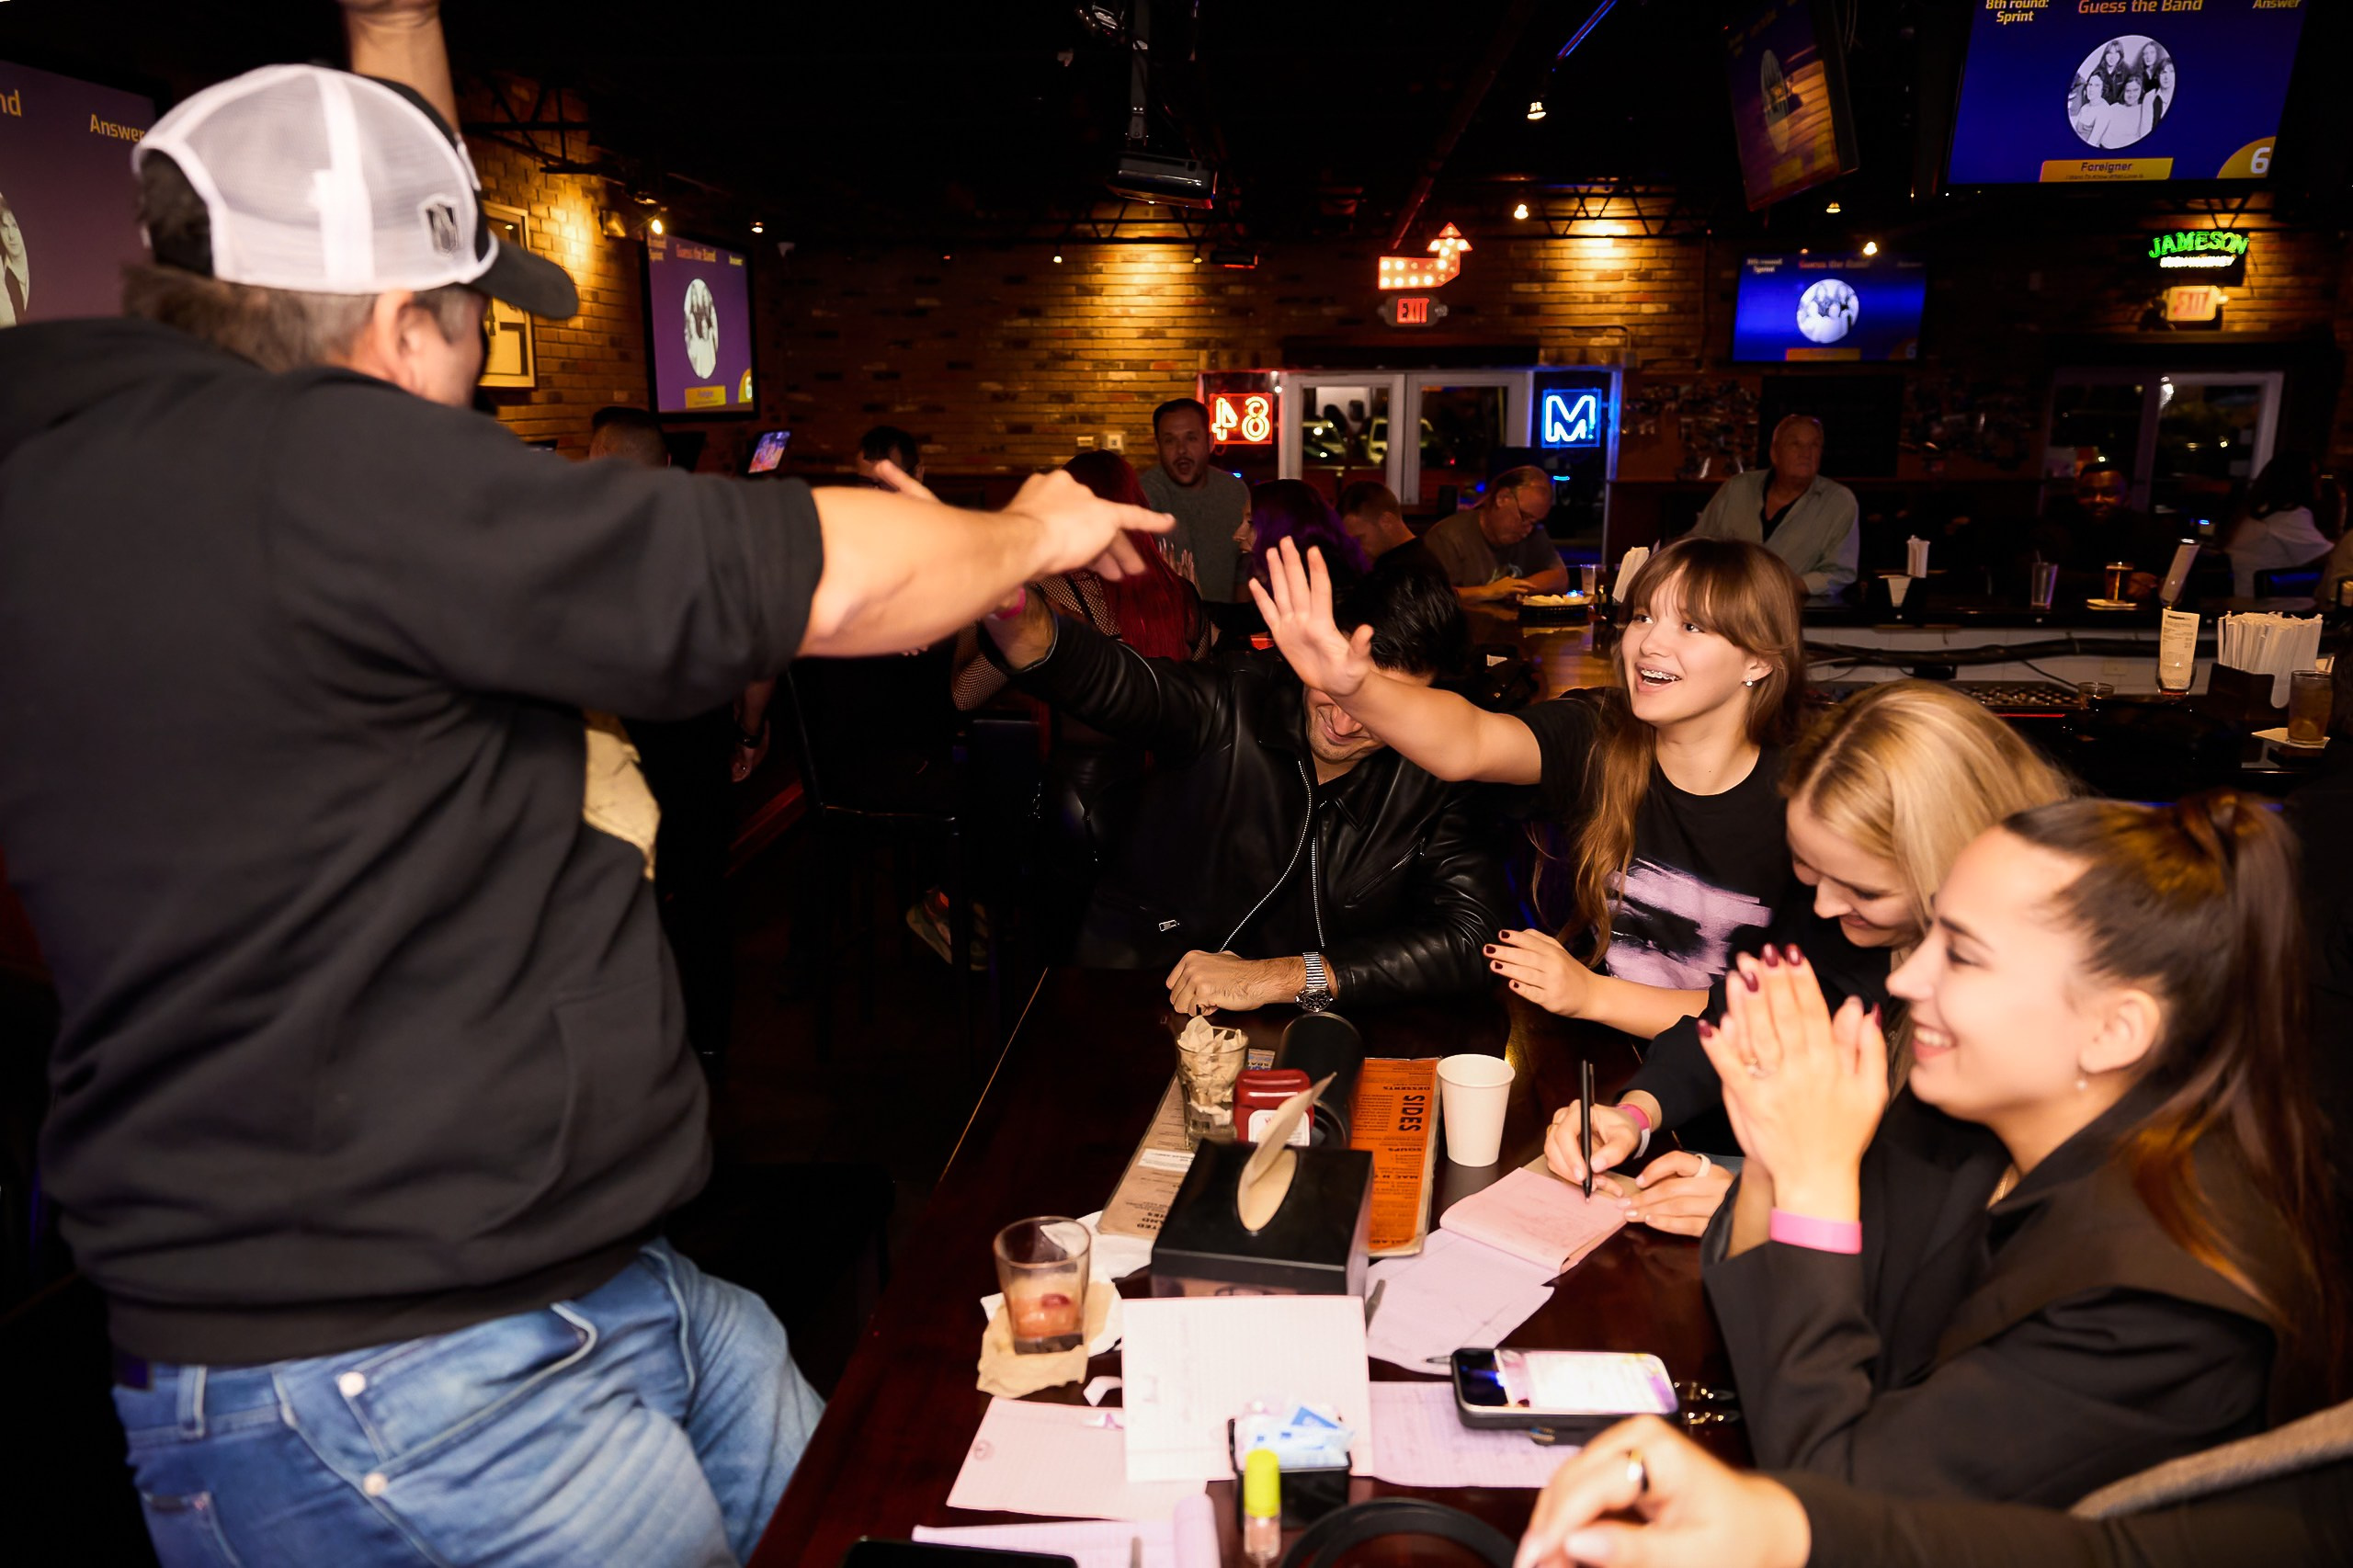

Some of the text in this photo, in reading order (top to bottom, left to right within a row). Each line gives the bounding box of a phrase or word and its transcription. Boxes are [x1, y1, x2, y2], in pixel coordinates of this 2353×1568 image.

[1996, 11, 2034, 25] Sprint
[2078, 0, 2203, 14] Guess the Band
[2081, 162, 2132, 173] Foreigner
[2251, 147, 2270, 174] 6
[2148, 231, 2249, 258] JAMESON
[1397, 298, 1430, 324] EXIT
[2174, 291, 2210, 316] EXIT
[1398, 1095, 1426, 1132] SIDES
